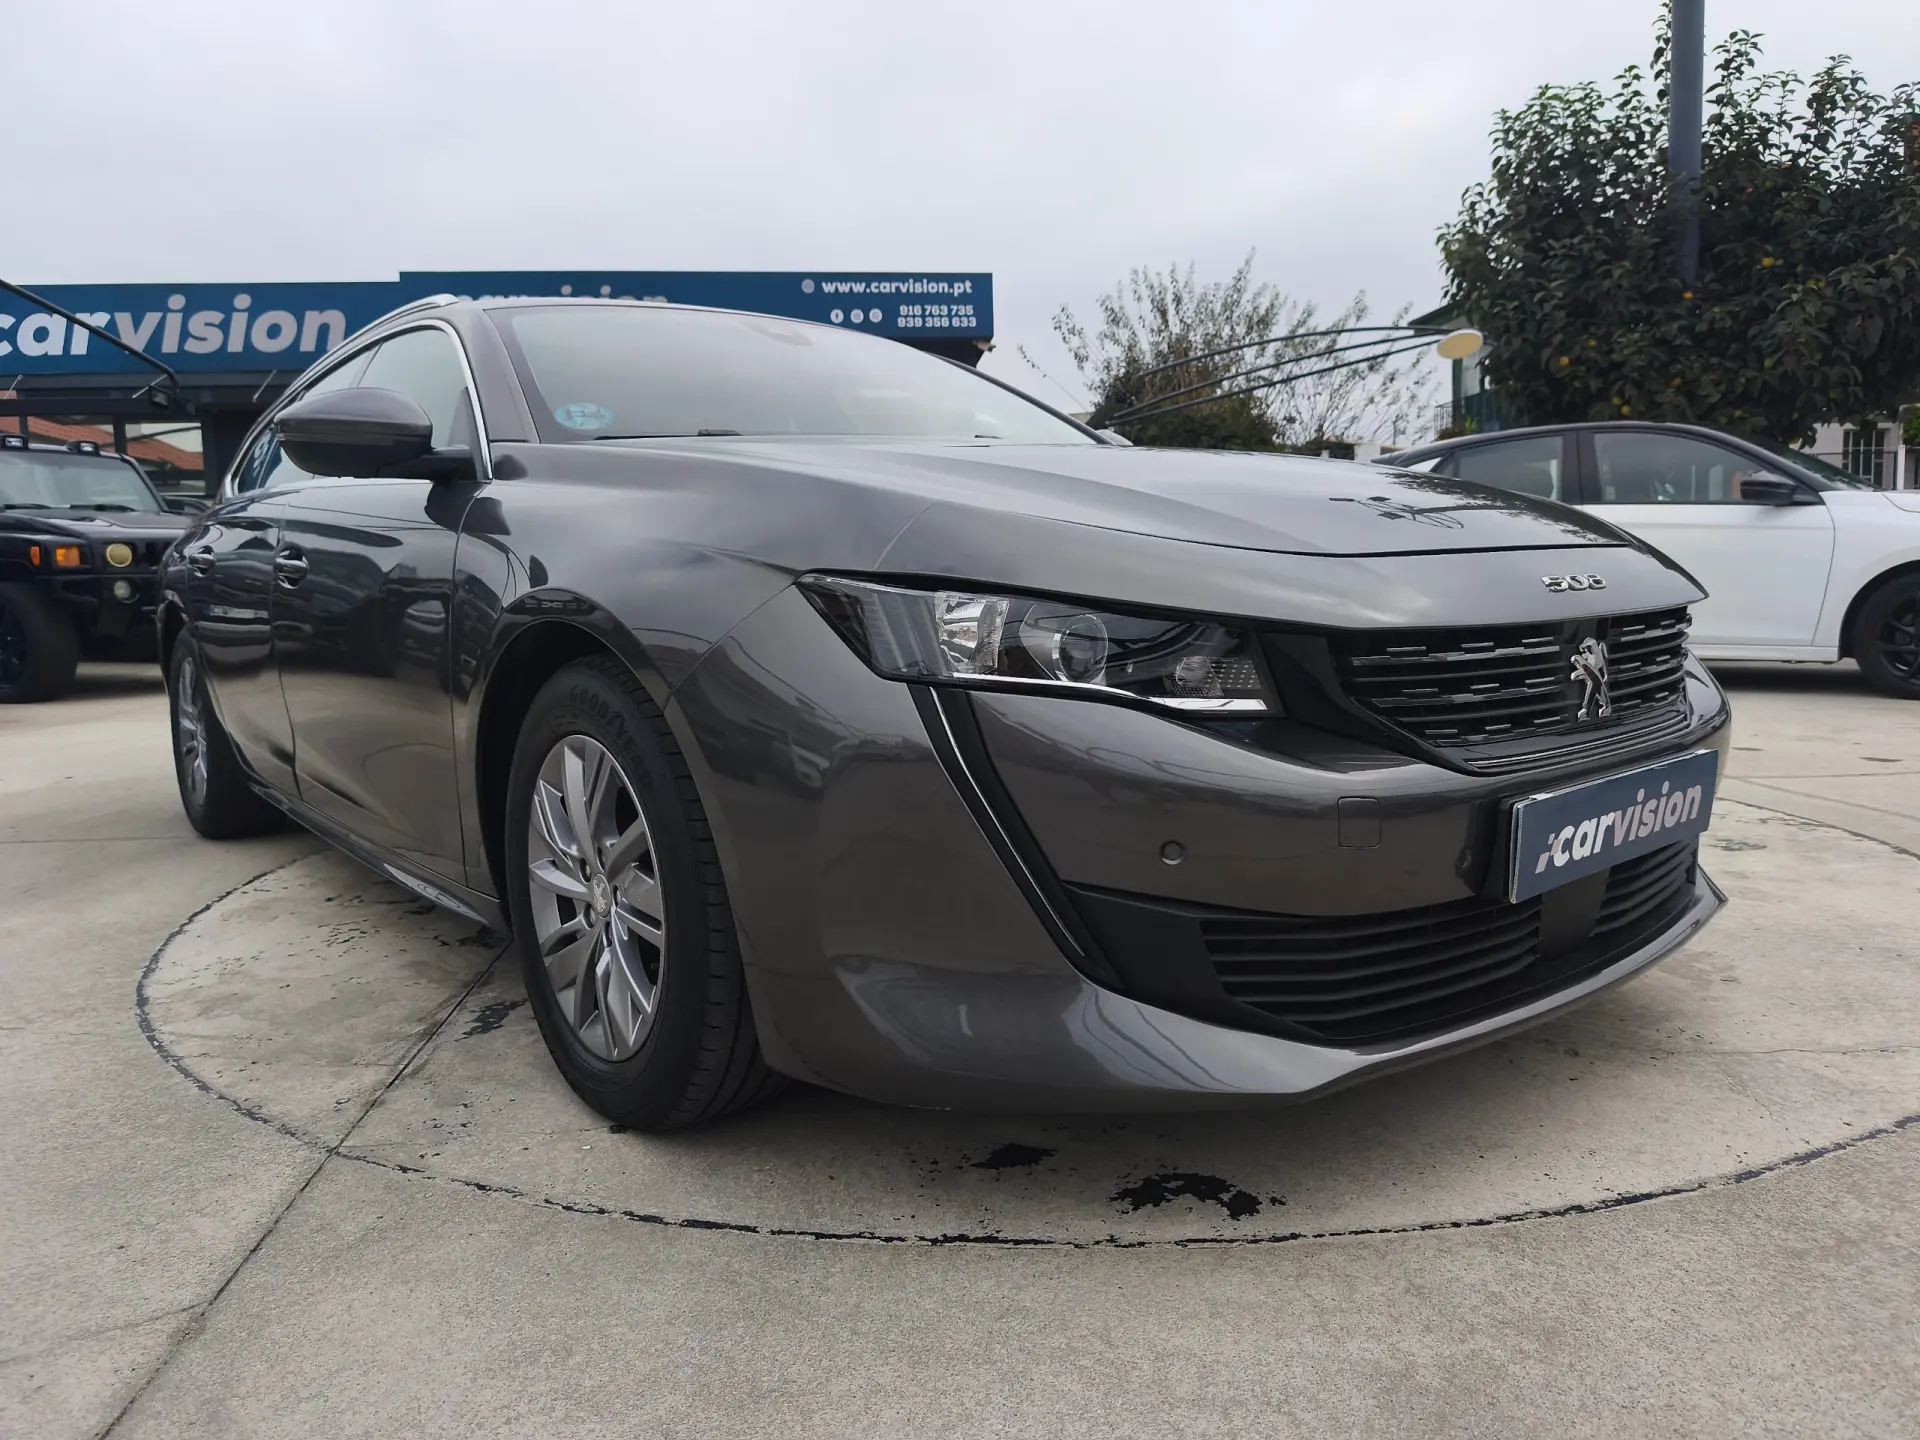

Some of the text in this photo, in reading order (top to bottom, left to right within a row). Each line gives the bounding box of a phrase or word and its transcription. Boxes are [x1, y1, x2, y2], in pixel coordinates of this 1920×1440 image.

[821, 278, 973, 297] www.carvision.pt
[1541, 573, 1606, 592] 508
[1553, 780, 1702, 867] carvision
